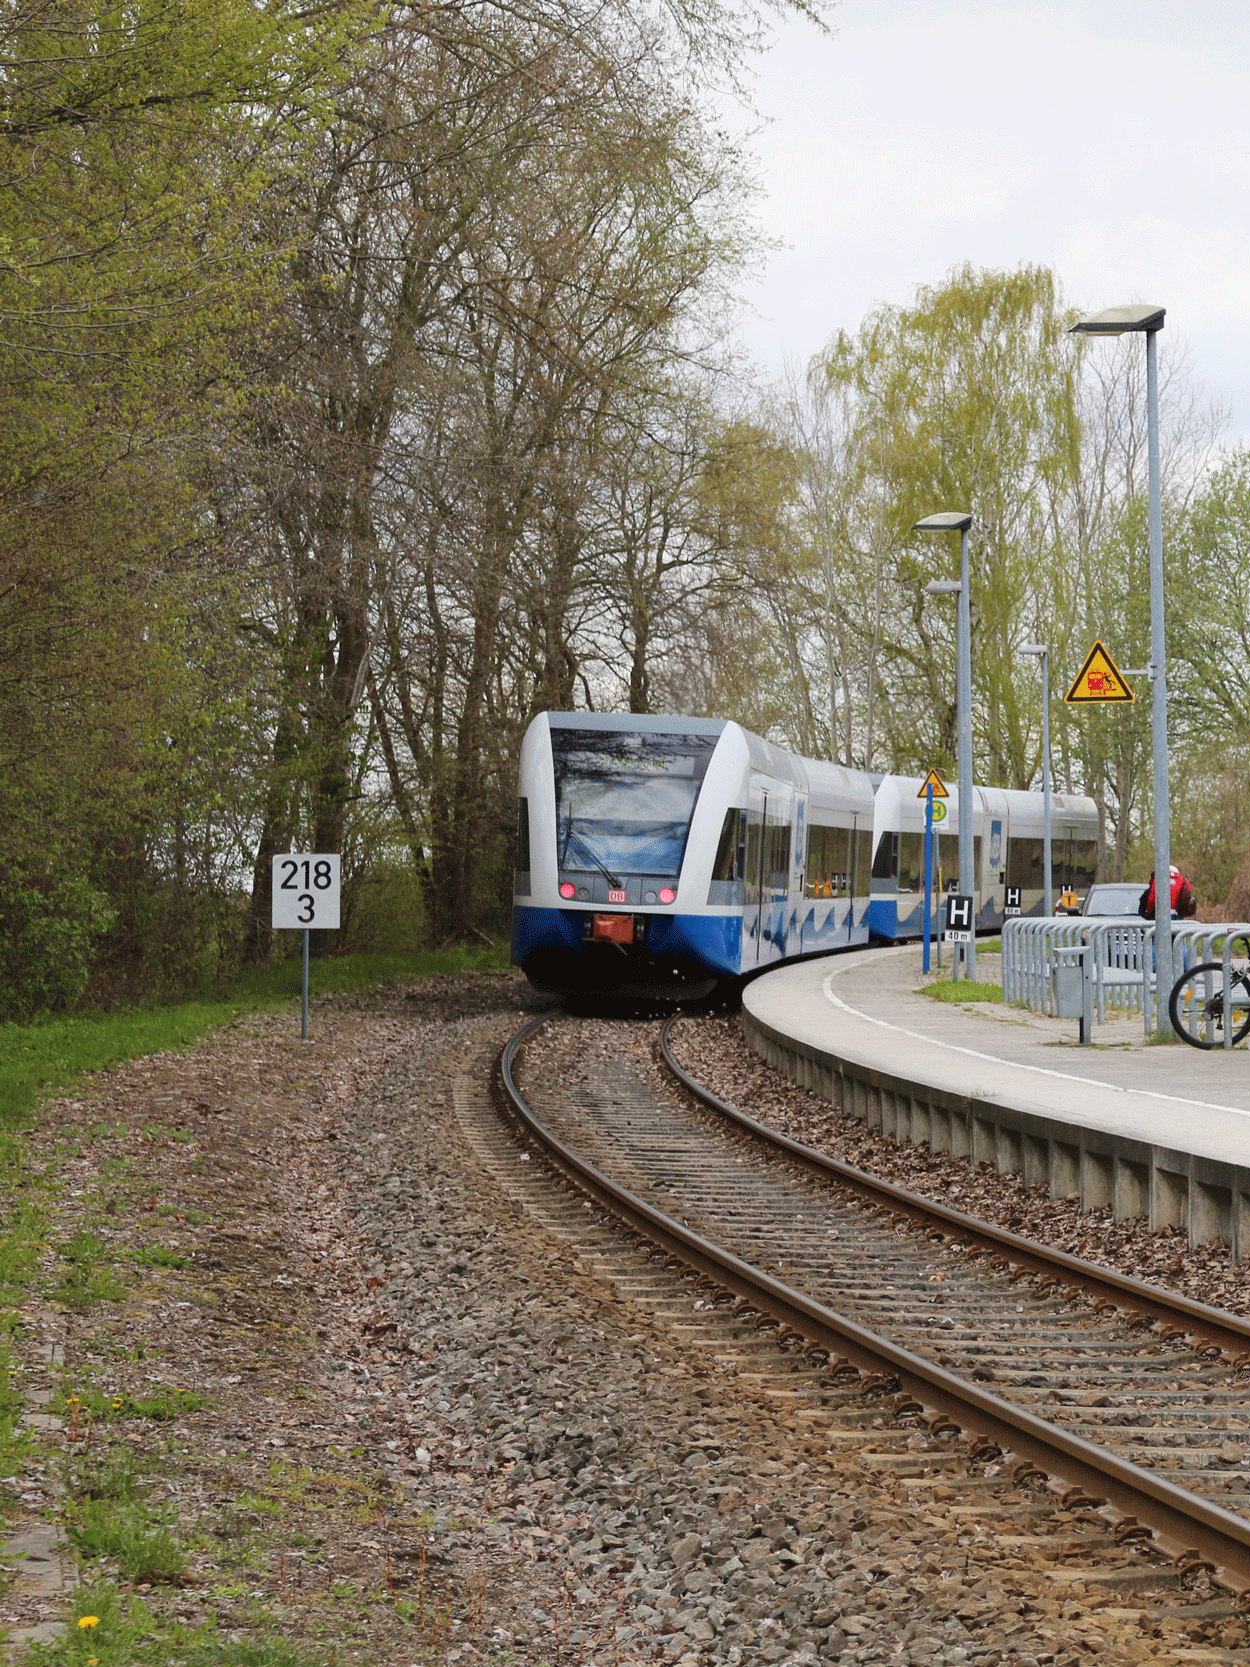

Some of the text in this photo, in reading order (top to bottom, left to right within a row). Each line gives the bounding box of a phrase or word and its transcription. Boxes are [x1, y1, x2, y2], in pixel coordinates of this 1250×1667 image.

[280, 859, 332, 890] 218
[609, 891, 624, 901] DB
[1007, 888, 1020, 905] H
[297, 893, 315, 924] 3
[950, 899, 969, 926] H
[948, 931, 959, 941] 40
